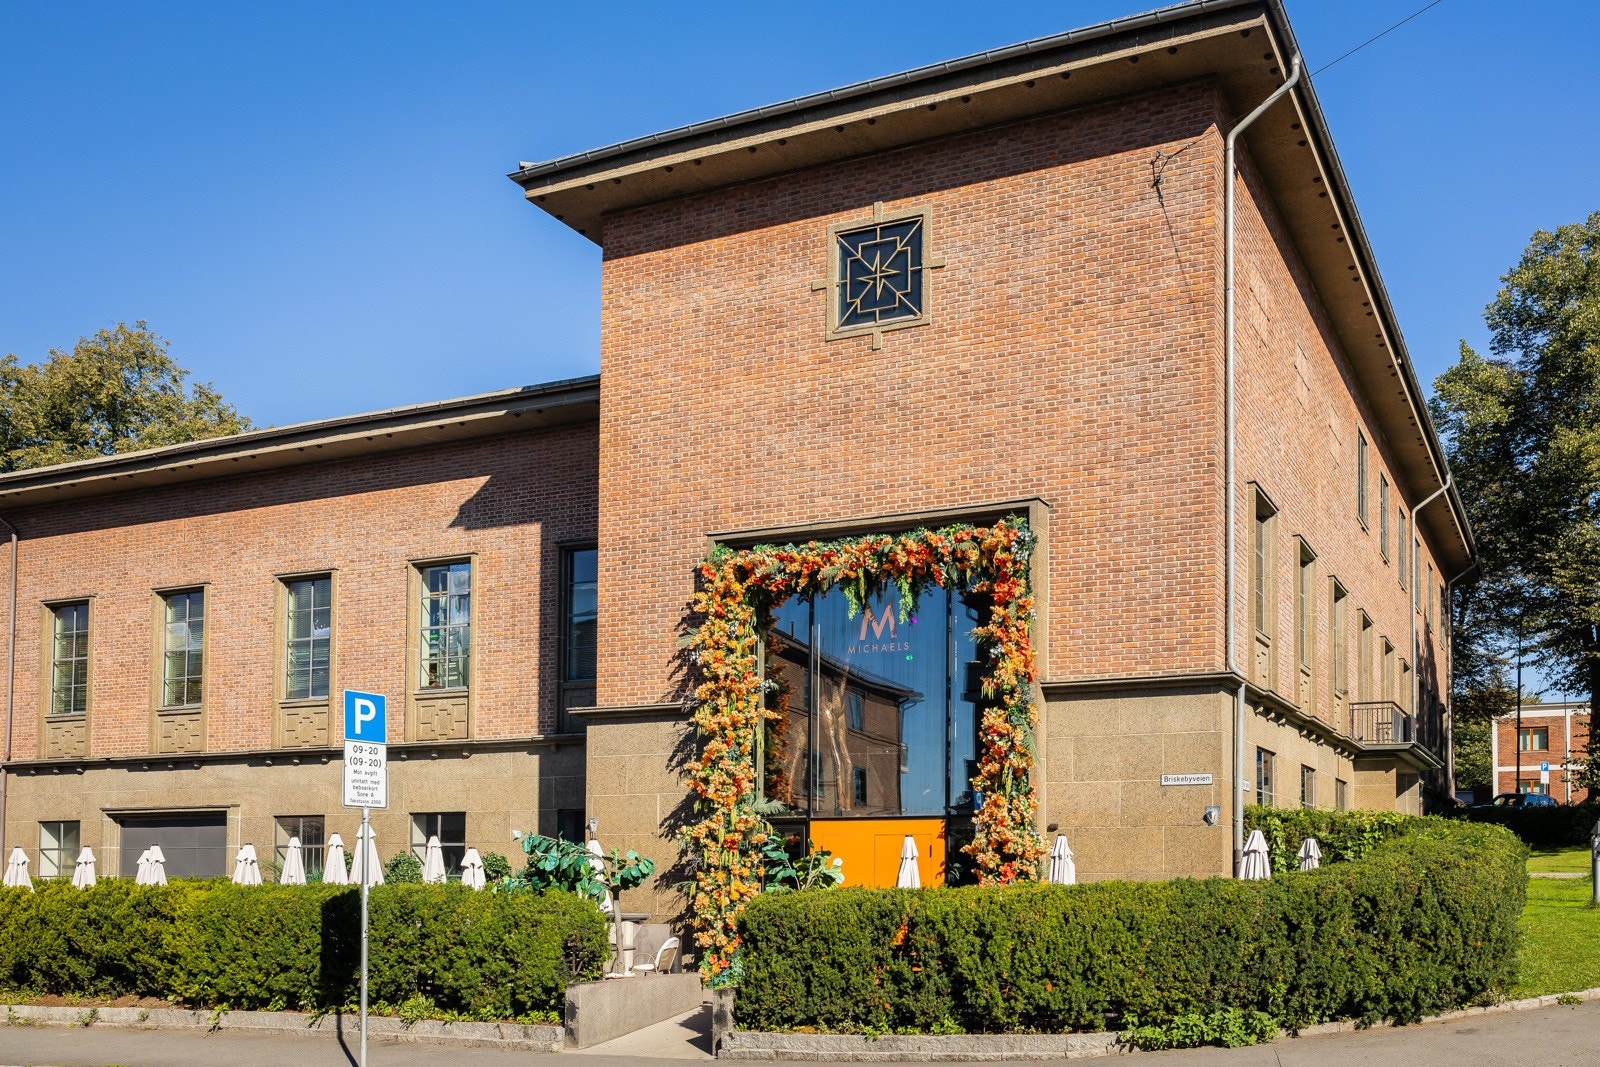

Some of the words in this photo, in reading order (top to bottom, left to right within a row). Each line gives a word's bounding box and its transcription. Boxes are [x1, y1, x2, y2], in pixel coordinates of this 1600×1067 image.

[860, 601, 897, 640] M
[848, 642, 909, 654] MICHAELS
[355, 698, 376, 734] P
[353, 745, 378, 755] 09-20
[350, 757, 381, 768] (09-20)
